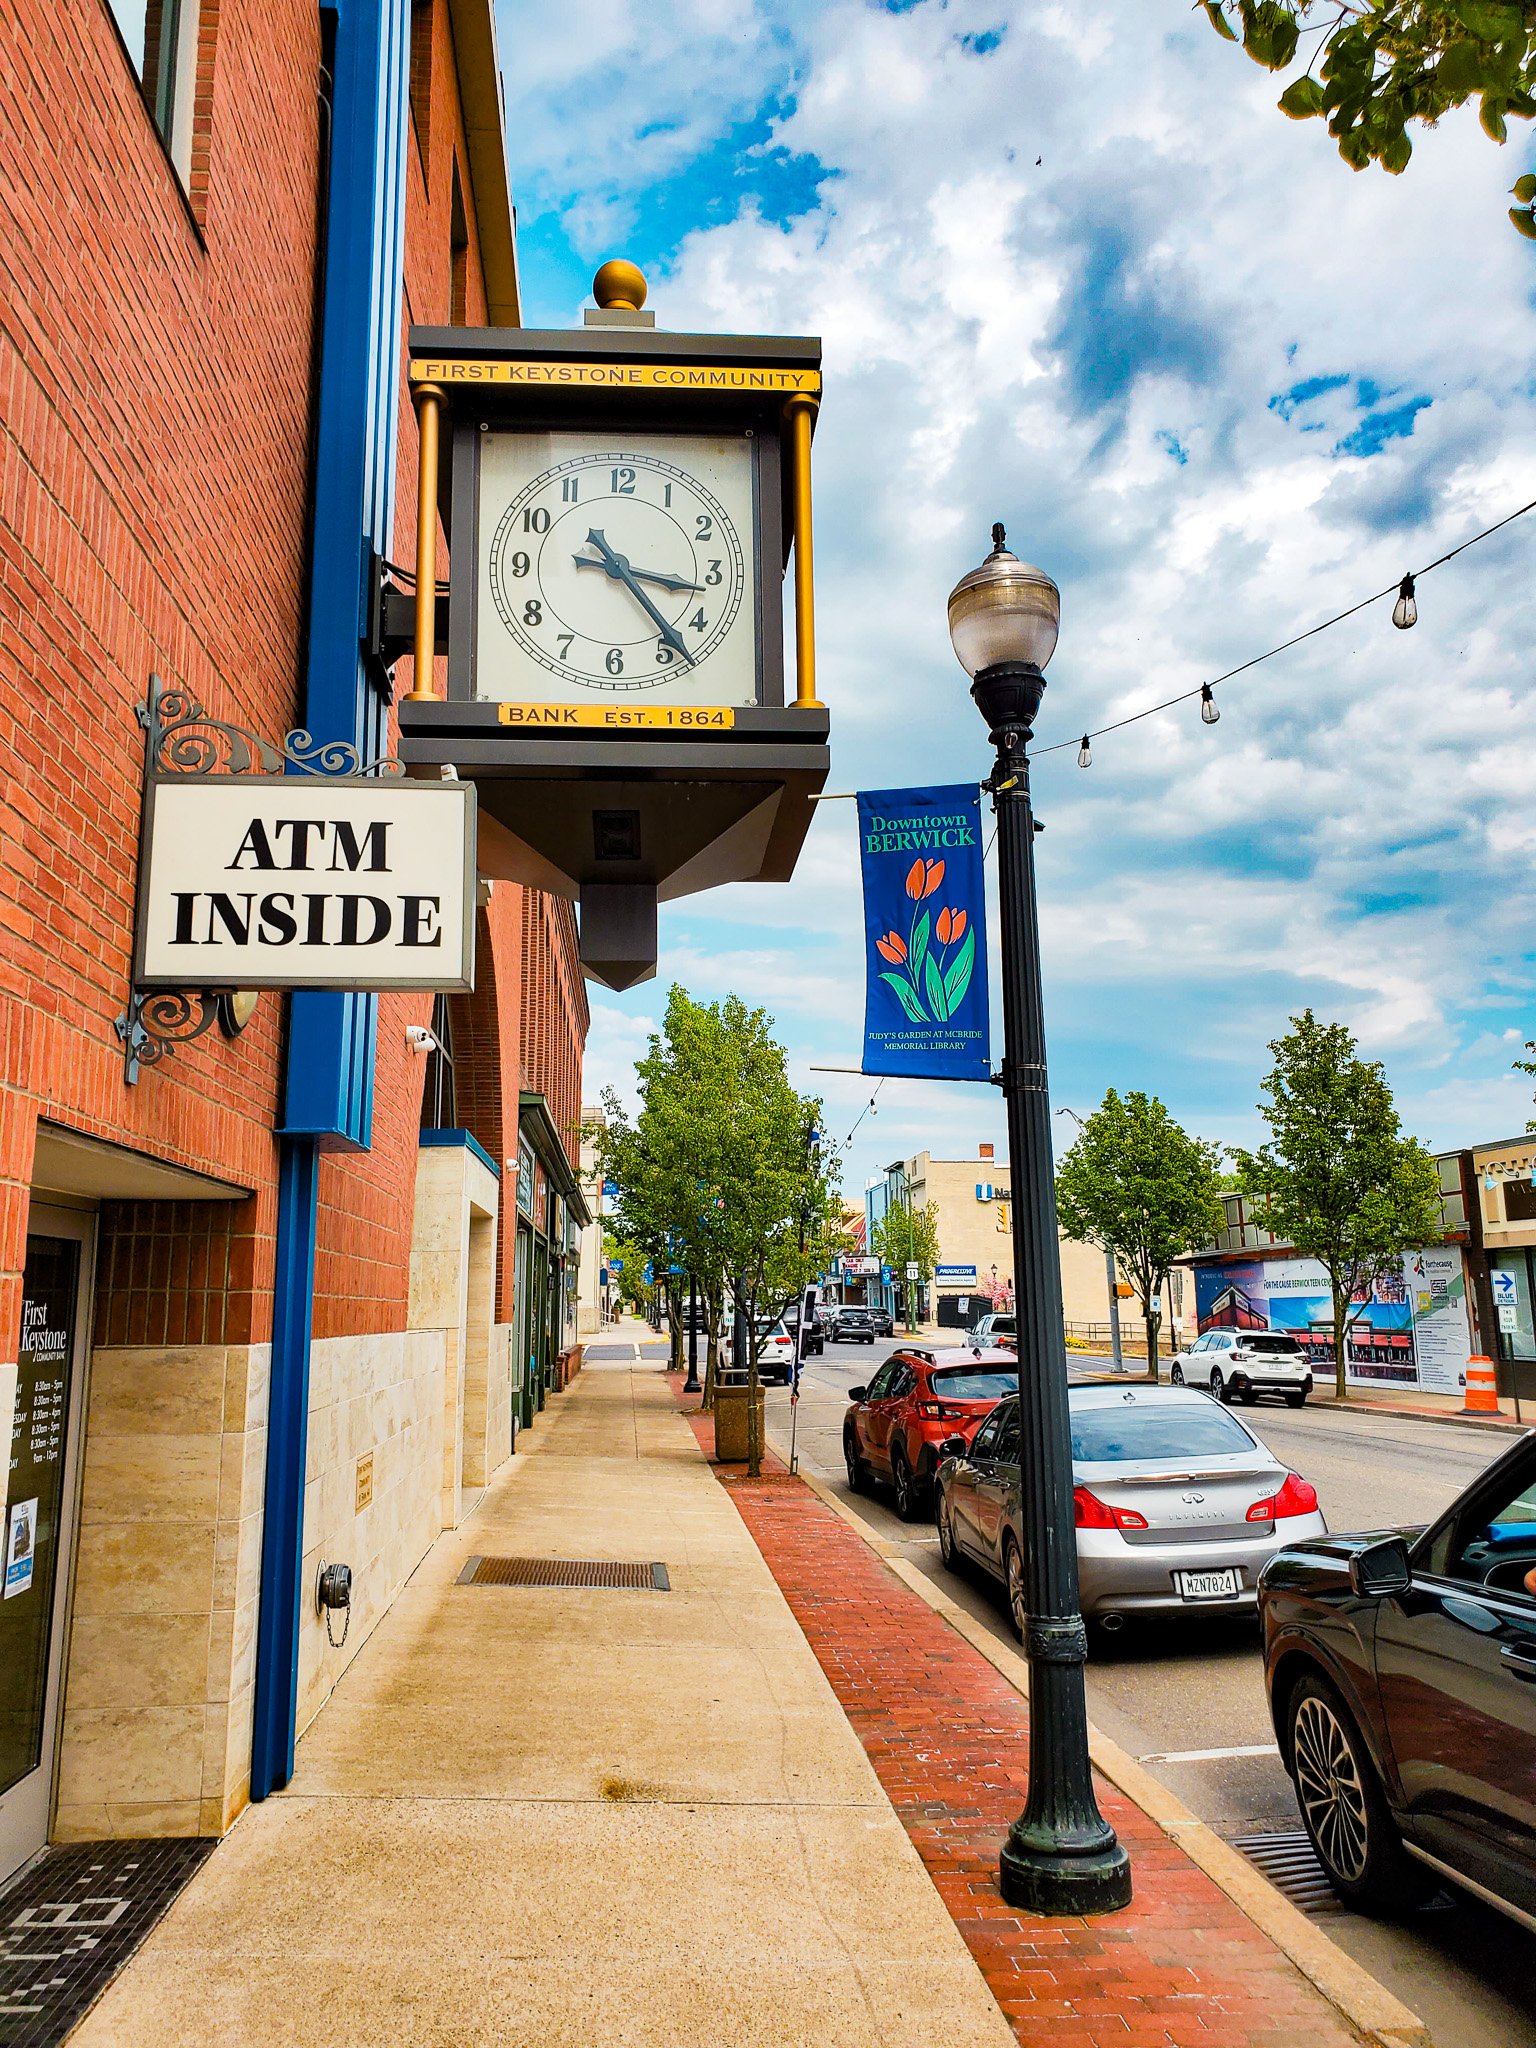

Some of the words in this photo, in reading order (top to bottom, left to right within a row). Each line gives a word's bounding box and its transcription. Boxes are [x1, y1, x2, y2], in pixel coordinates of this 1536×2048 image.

[426, 364, 499, 379] FIRST
[509, 366, 642, 383] KEYSTONE
[652, 370, 805, 387] COMMUNITY
[562, 477, 578, 502] 11
[611, 468, 636, 494] 12
[664, 483, 672, 508] 1
[523, 508, 551, 534] 10
[695, 516, 712, 541] 2
[512, 552, 530, 577] 9
[705, 560, 723, 585] 3
[523, 600, 543, 626] 8
[688, 607, 709, 633] 4
[556, 634, 575, 660] 7
[656, 639, 674, 664] 5
[606, 649, 624, 675] 6
[508, 707, 579, 723] BANK
[604, 711, 653, 725] EST.
[666, 711, 725, 726] 1864
[871, 815, 968, 833] Downtown
[224, 818, 394, 872] ATM
[865, 827, 976, 853] BERWICK
[168, 893, 442, 948] INSIDE
[868, 1032, 896, 1040] JUDY'S
[898, 1031, 932, 1039] GARDEN
[944, 1030, 983, 1039] MCBRIDE
[930, 1042, 966, 1050] LIBRARY
[994, 1188, 1011, 1198] Na
[23, 1300, 47, 1325] First
[22, 1326, 66, 1362] Keystone
[1169, 1511, 1224, 1520] INFINITI
